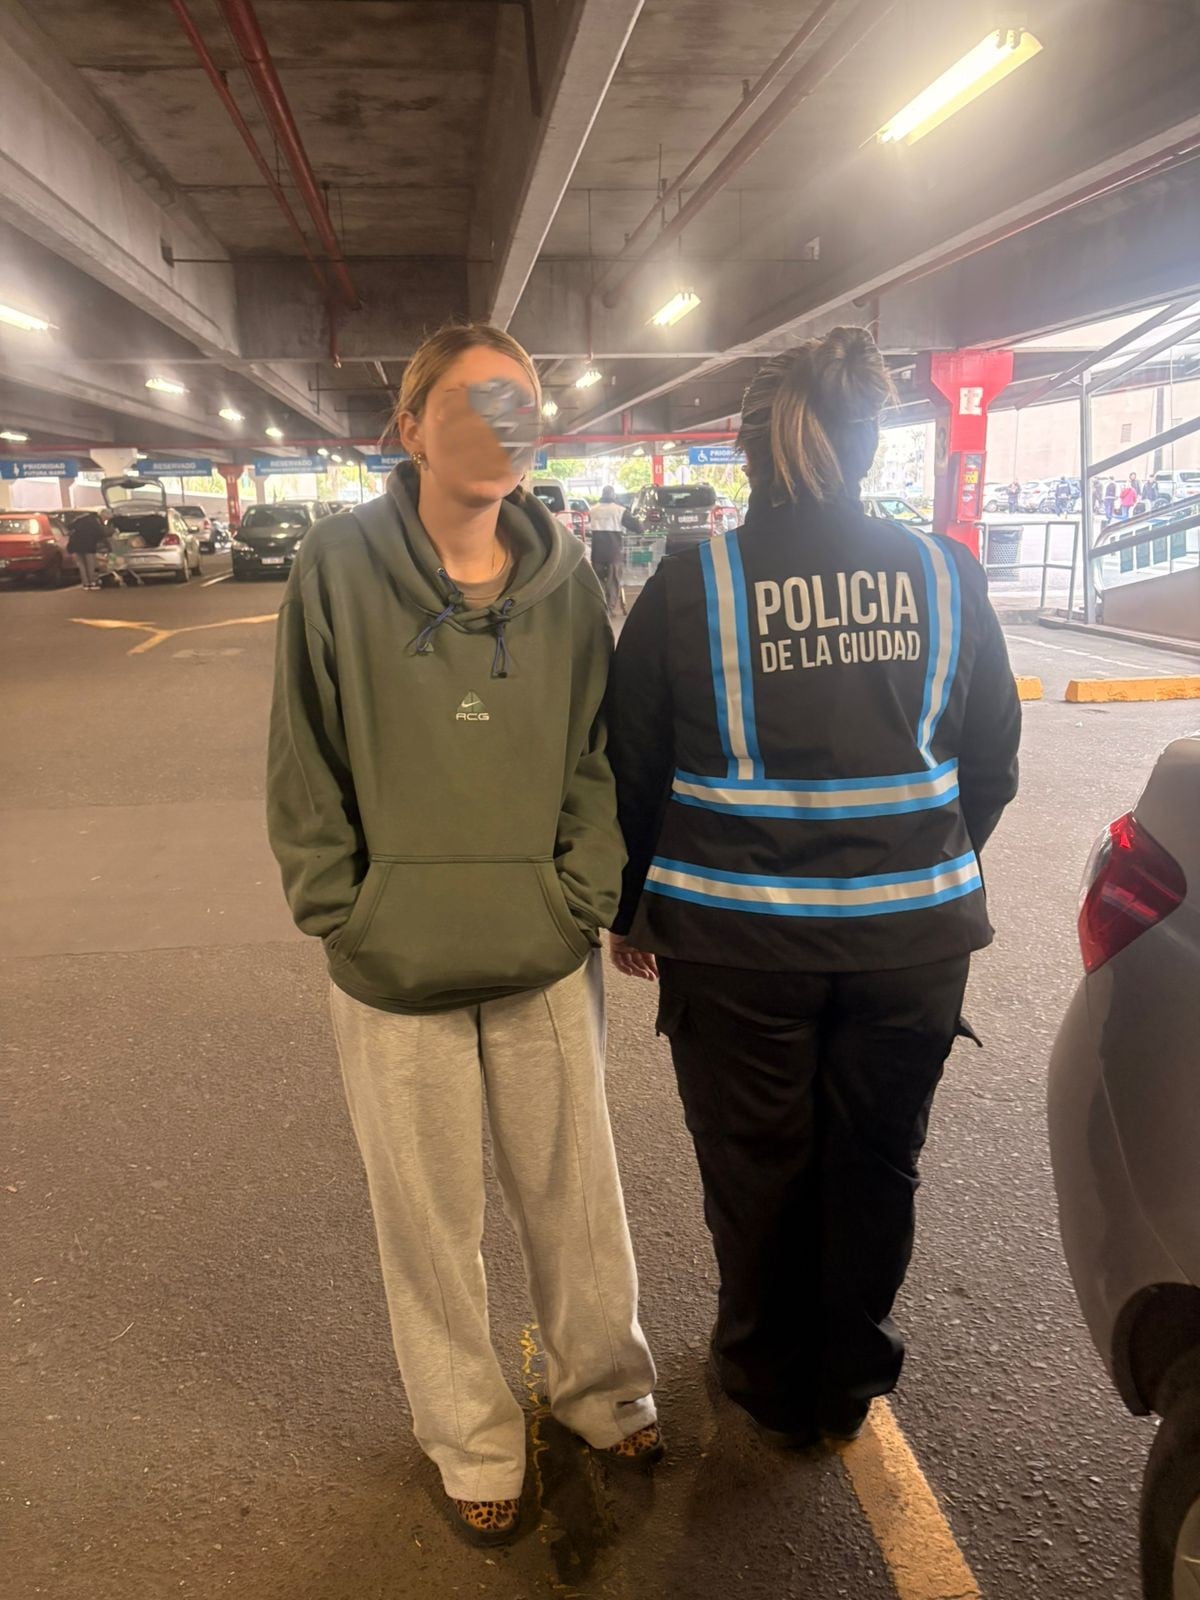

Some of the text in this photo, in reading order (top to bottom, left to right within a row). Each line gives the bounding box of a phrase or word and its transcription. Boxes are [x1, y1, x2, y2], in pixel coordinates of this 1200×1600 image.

[22, 462, 65, 470] PRIORIDAD
[153, 462, 197, 470] RESERVADO
[754, 570, 919, 636] POLICIA
[760, 629, 921, 673] DE LA CIUDAD
[455, 712, 490, 721] ACG
